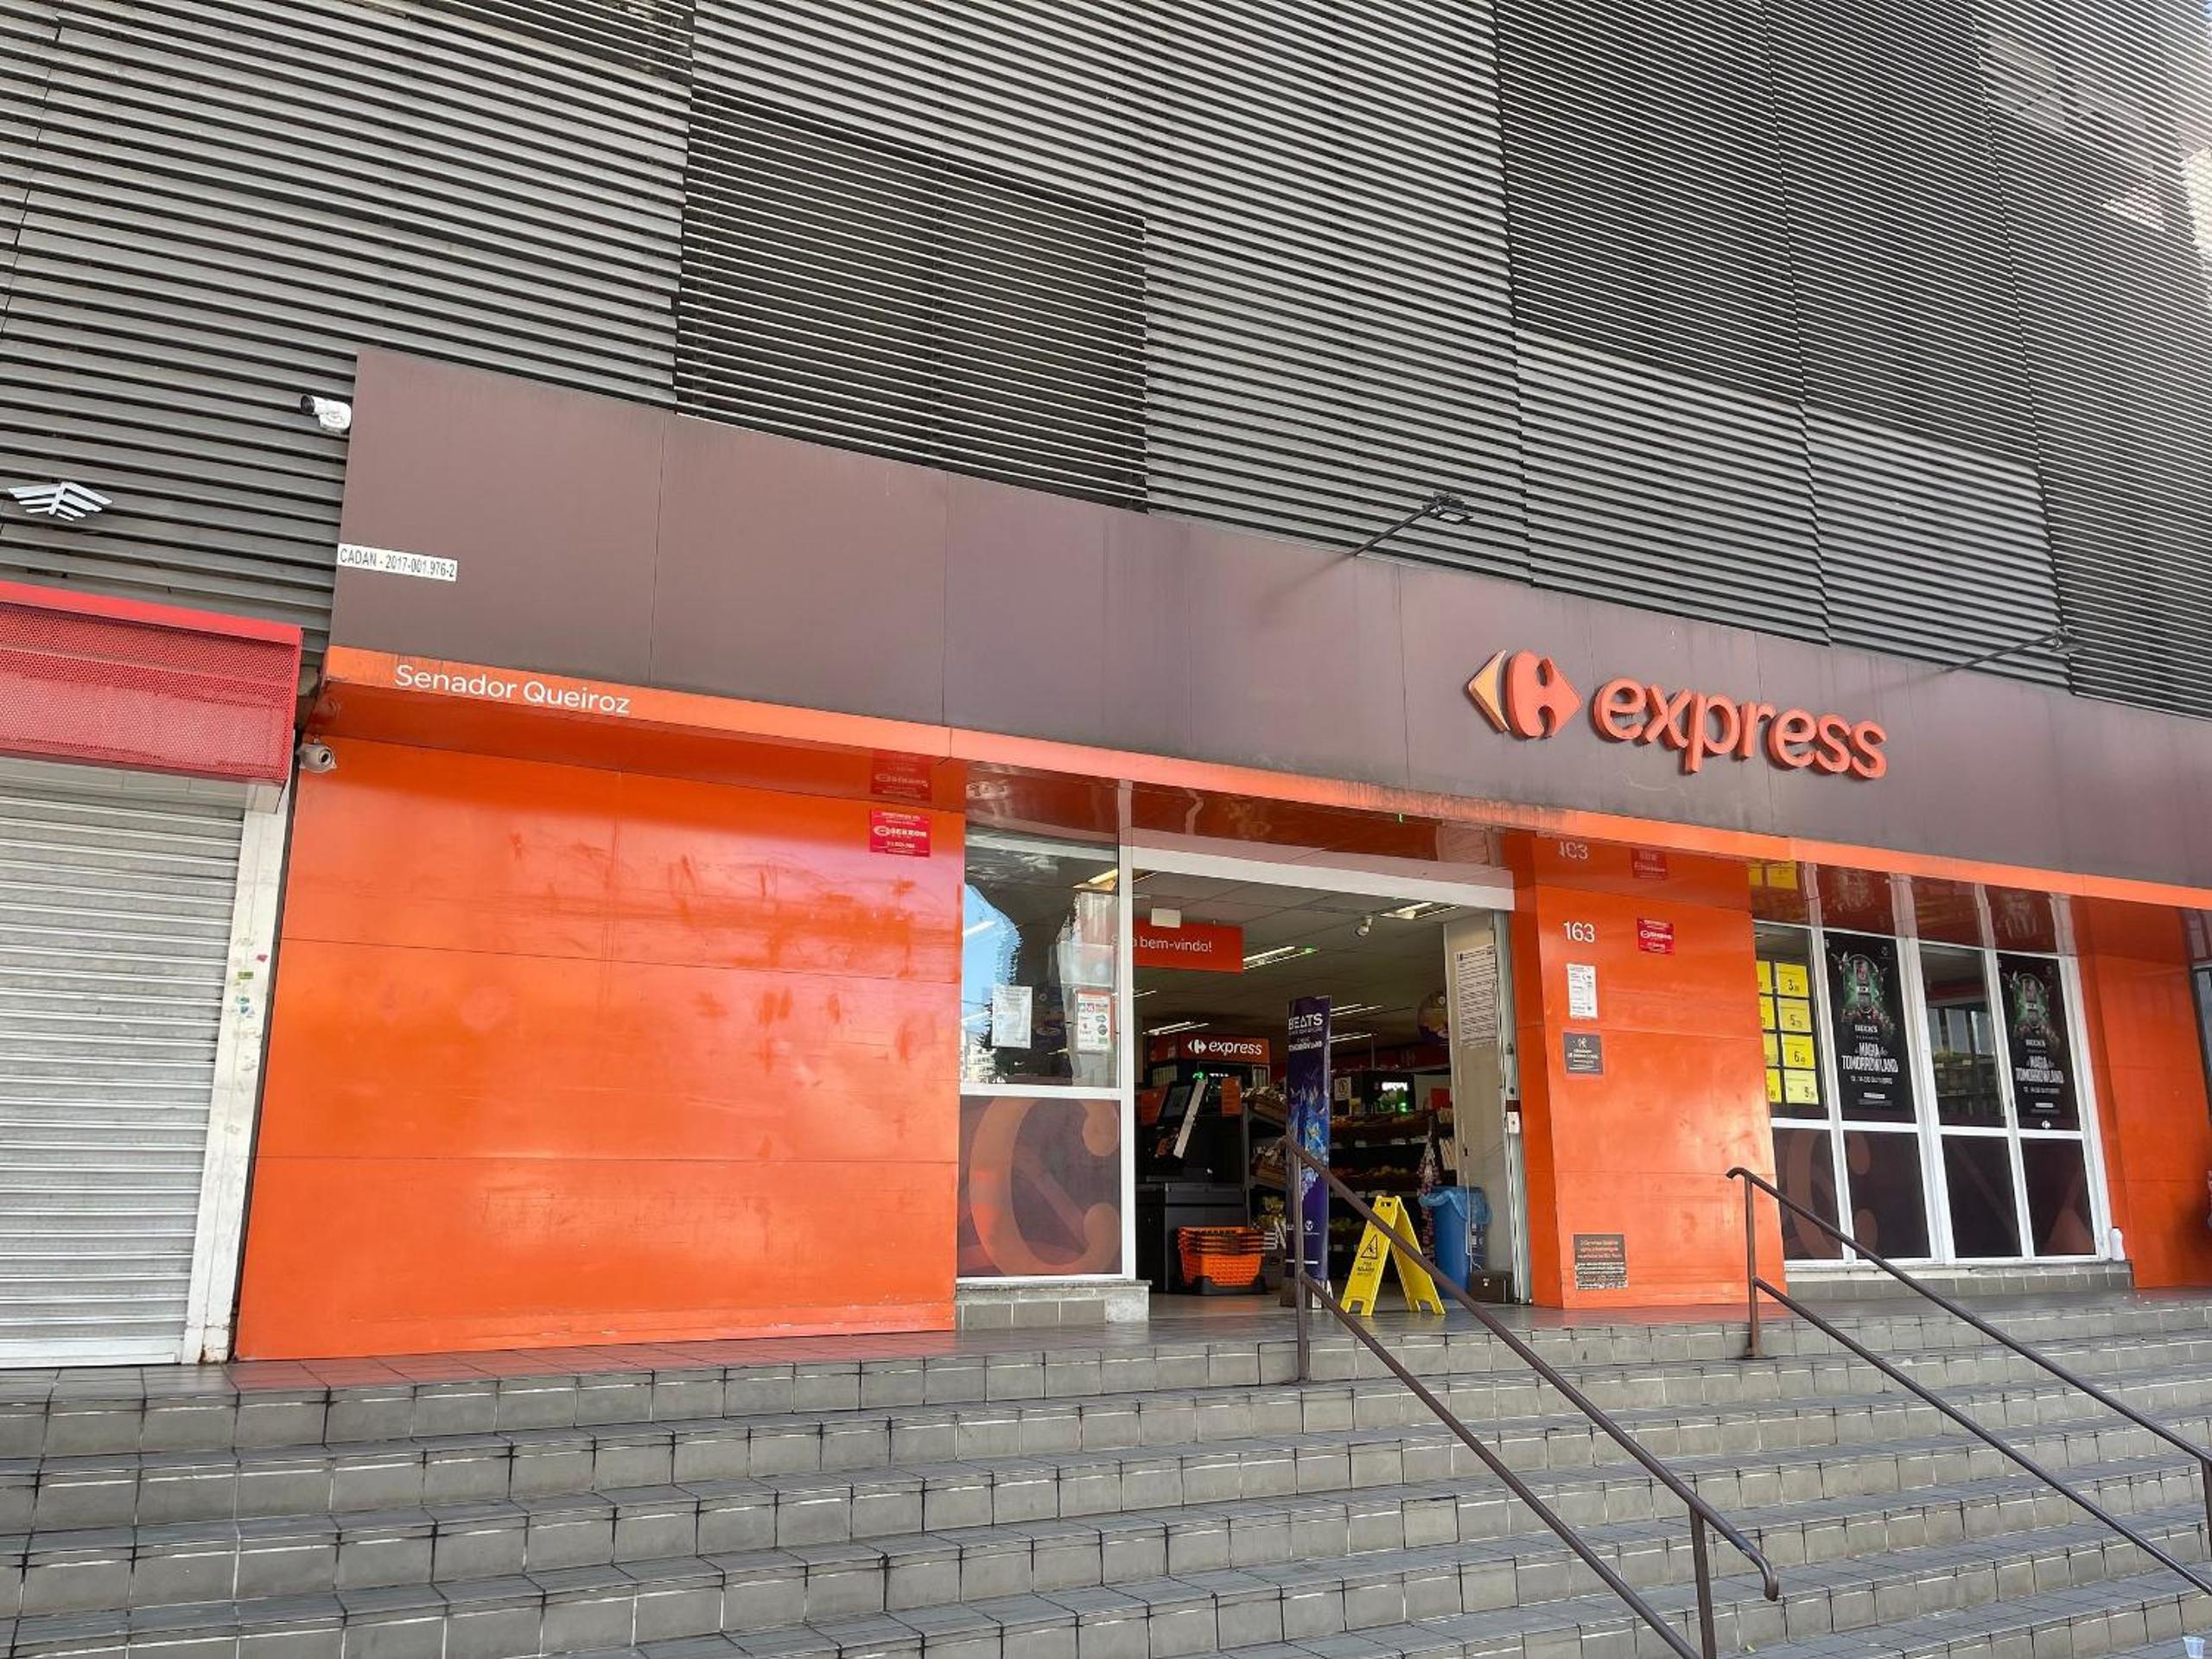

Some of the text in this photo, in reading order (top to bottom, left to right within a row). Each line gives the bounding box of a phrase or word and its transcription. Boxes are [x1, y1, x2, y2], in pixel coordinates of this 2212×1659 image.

[340, 548, 378, 567] CADAN
[395, 664, 631, 715] Senador Queiroz
[1592, 677, 1888, 779] express
[1563, 920, 1595, 944] 163
[1140, 935, 1212, 952] bem-vindo!
[1208, 1040, 1262, 1057] express
